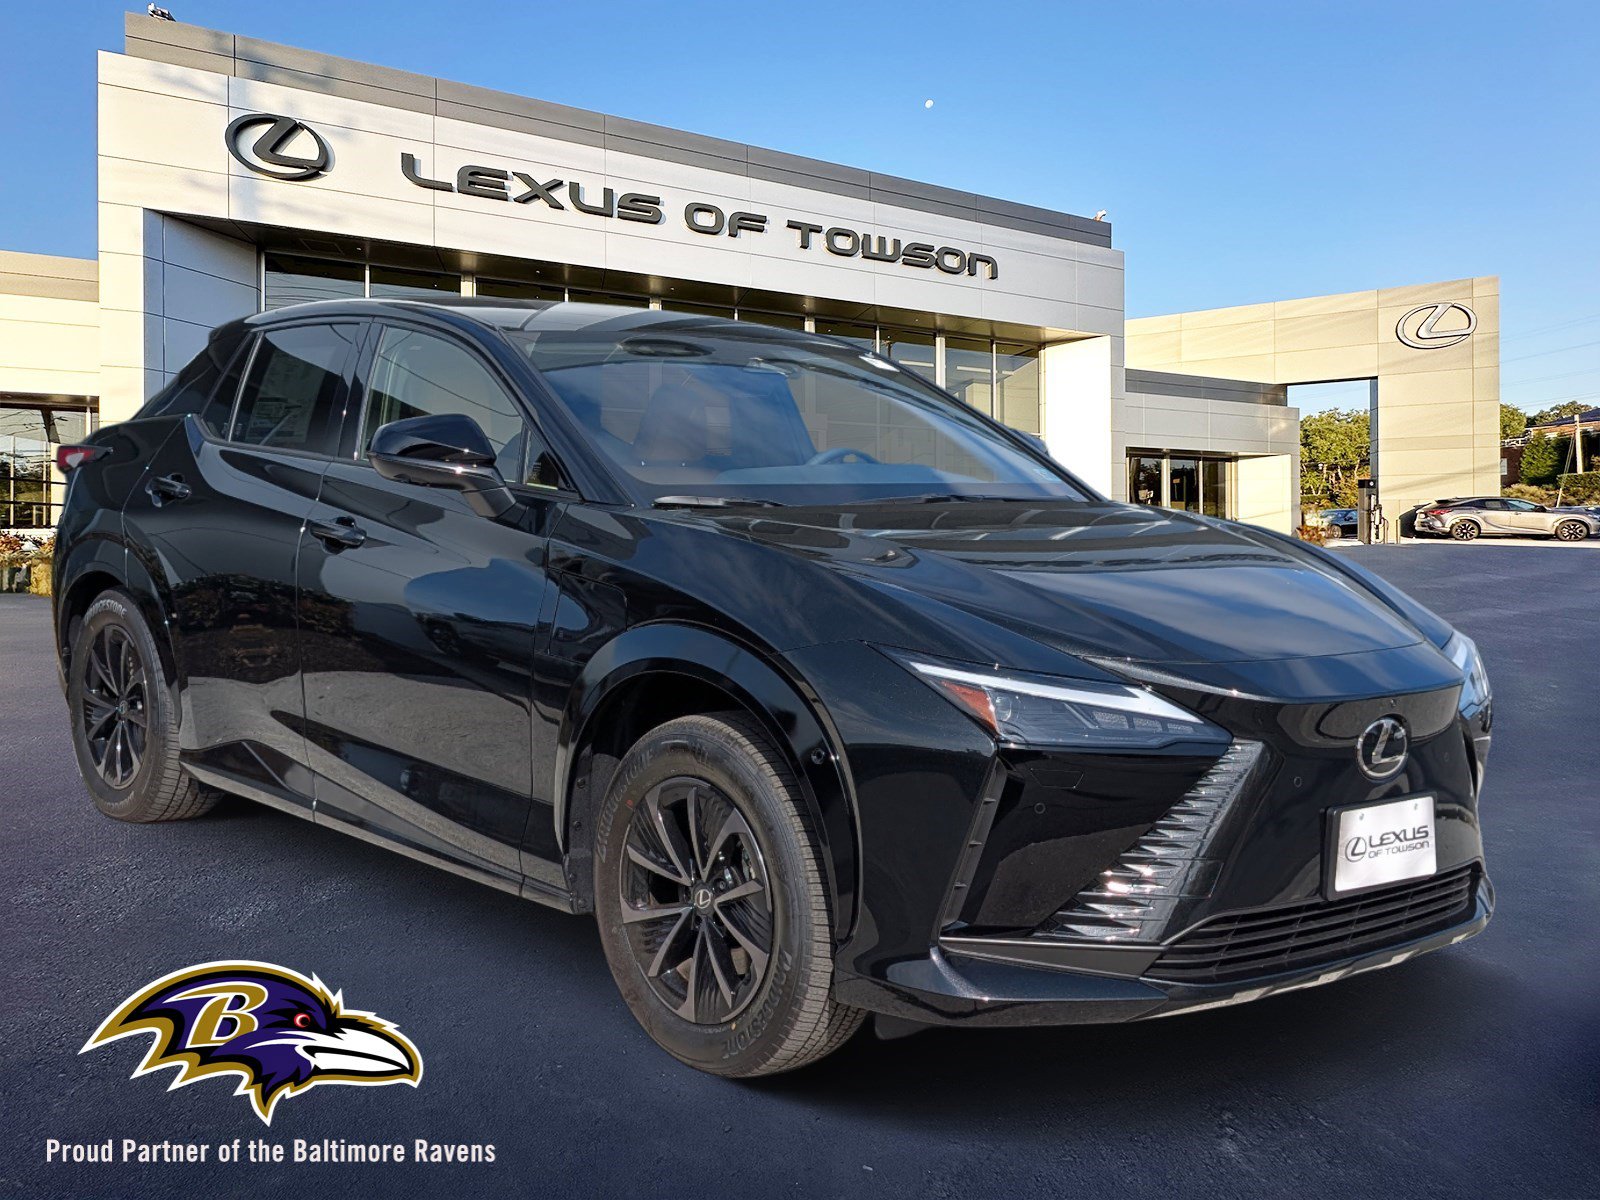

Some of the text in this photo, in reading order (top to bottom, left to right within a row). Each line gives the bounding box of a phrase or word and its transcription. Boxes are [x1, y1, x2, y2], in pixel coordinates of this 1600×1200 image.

[401, 152, 999, 280] LEXUS OF TOWSON
[1368, 825, 1430, 848] LEXUS
[1368, 841, 1430, 859] OF TOWSON
